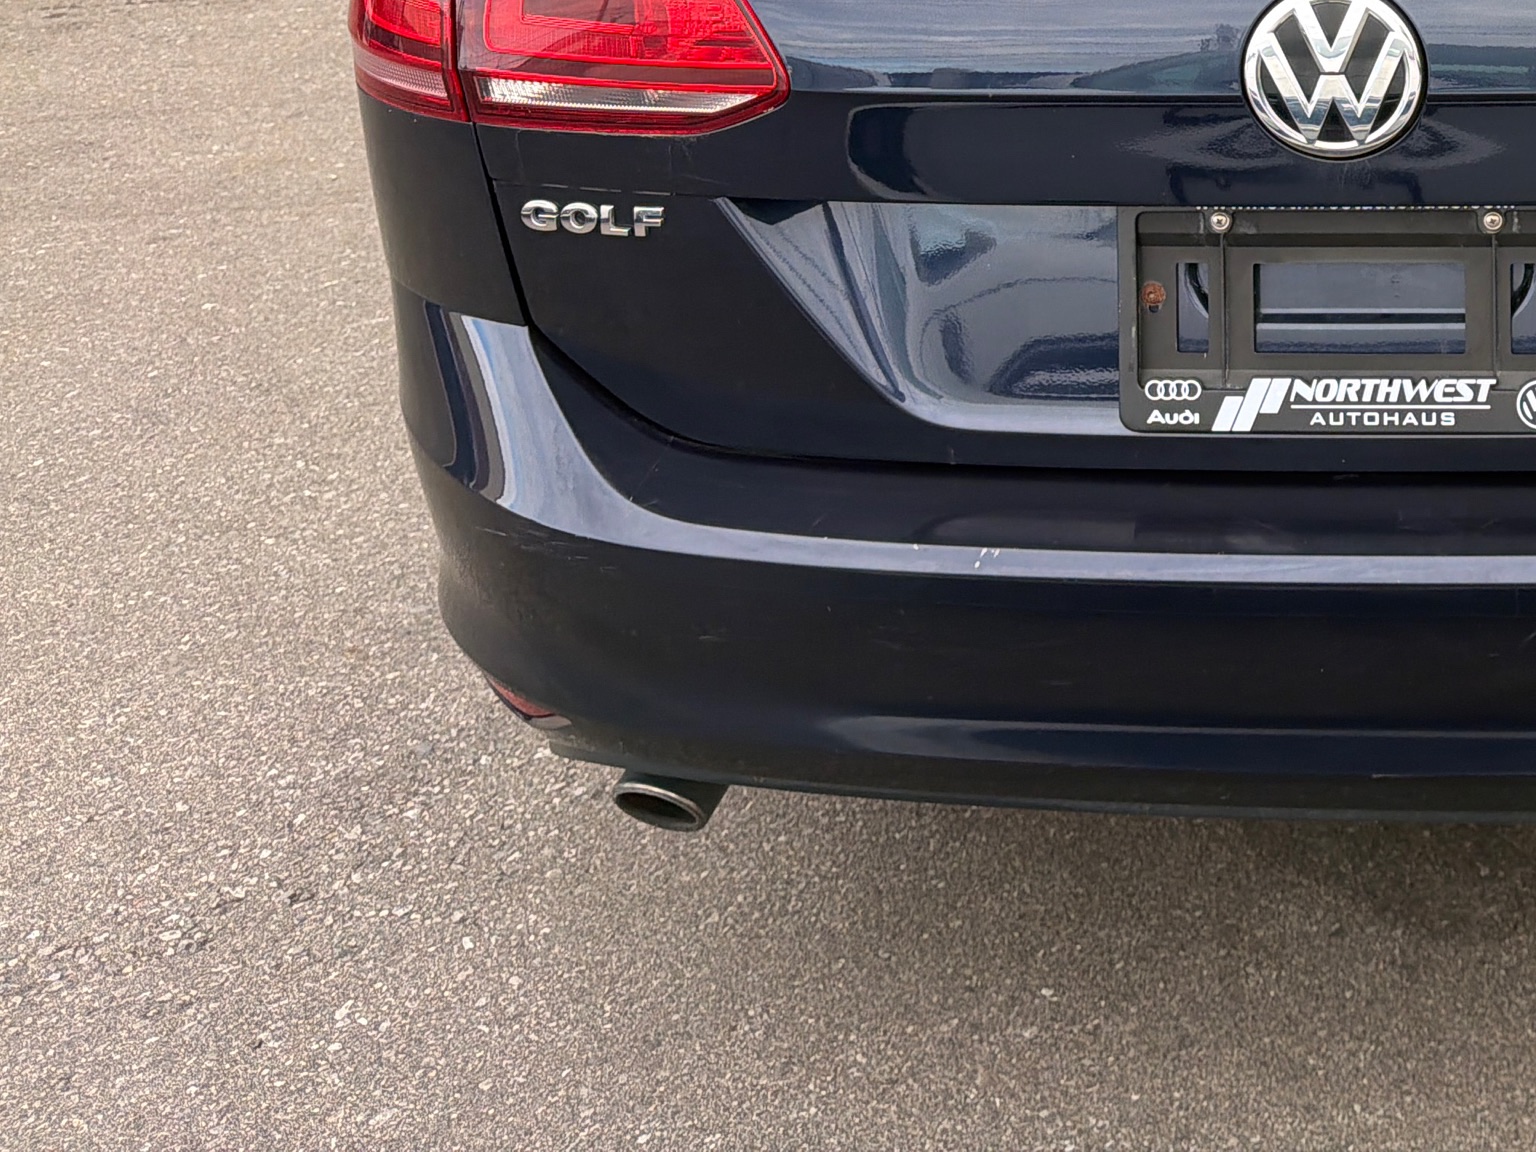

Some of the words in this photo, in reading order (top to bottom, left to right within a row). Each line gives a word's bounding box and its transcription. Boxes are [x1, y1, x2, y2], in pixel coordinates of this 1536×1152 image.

[520, 199, 665, 237] GOLF
[1290, 378, 1497, 403] NORTHWEST
[1146, 409, 1200, 425] Audi
[1310, 412, 1456, 426] AUTOHAUS
